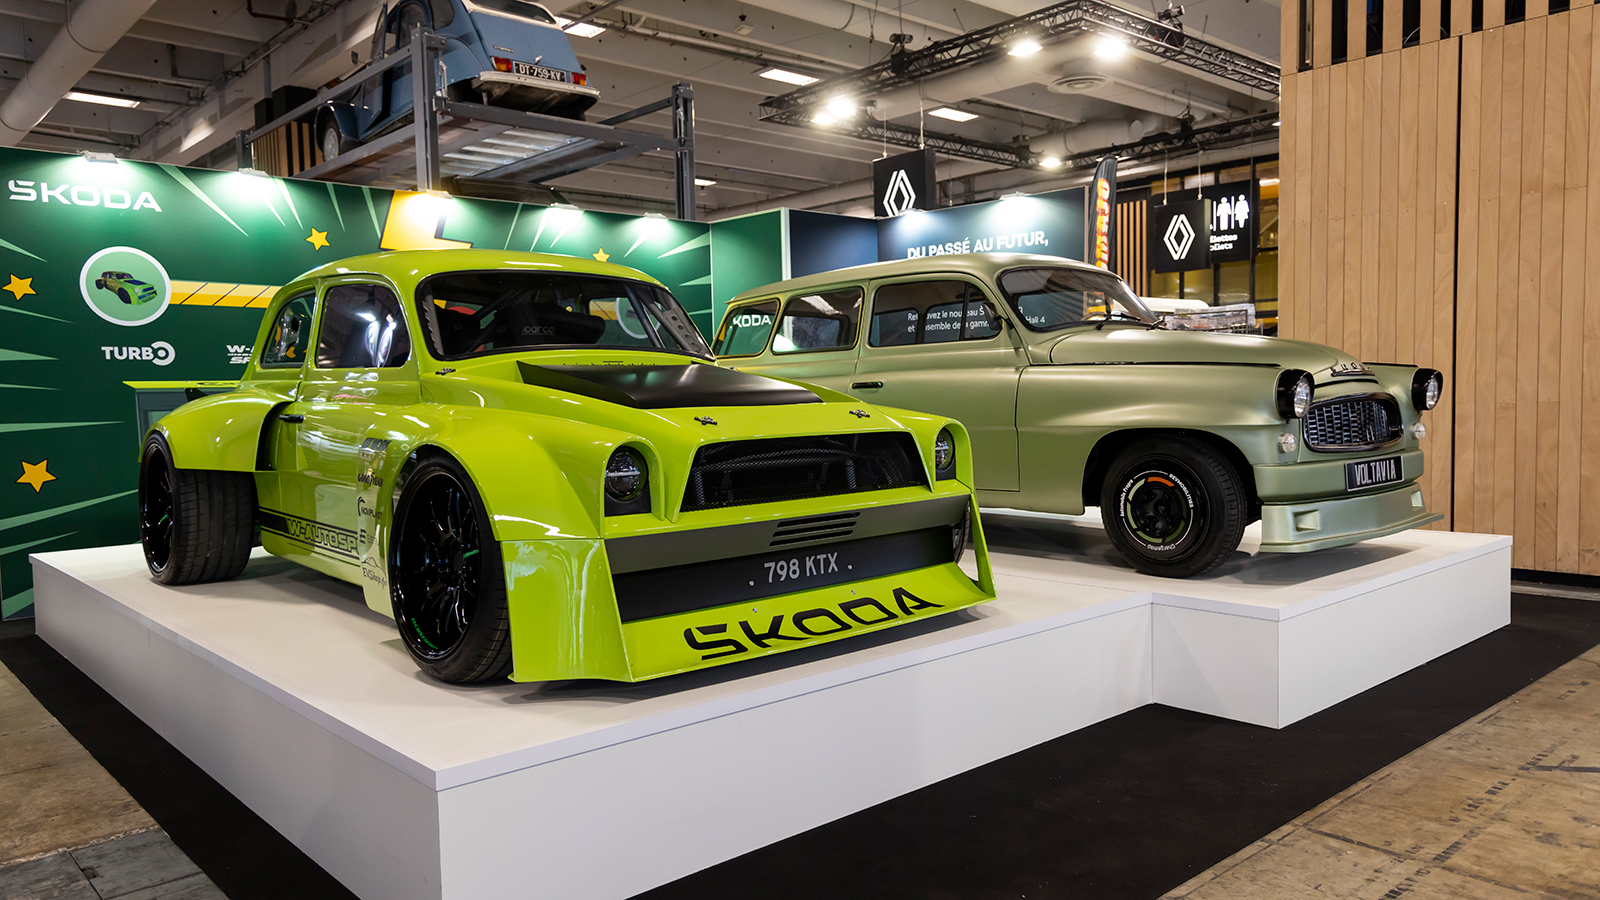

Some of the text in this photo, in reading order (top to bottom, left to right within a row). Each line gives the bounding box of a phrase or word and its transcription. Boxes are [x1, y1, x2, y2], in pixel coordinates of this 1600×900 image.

[907, 231, 1049, 260] DU PASSÉ AU FUTUR,
[908, 325, 916, 333] et
[952, 321, 961, 330] de
[942, 310, 948, 318] le
[101, 341, 176, 366] TURBO
[1354, 459, 1397, 486] VOLTAVIA
[763, 552, 839, 583] 798 KTX
